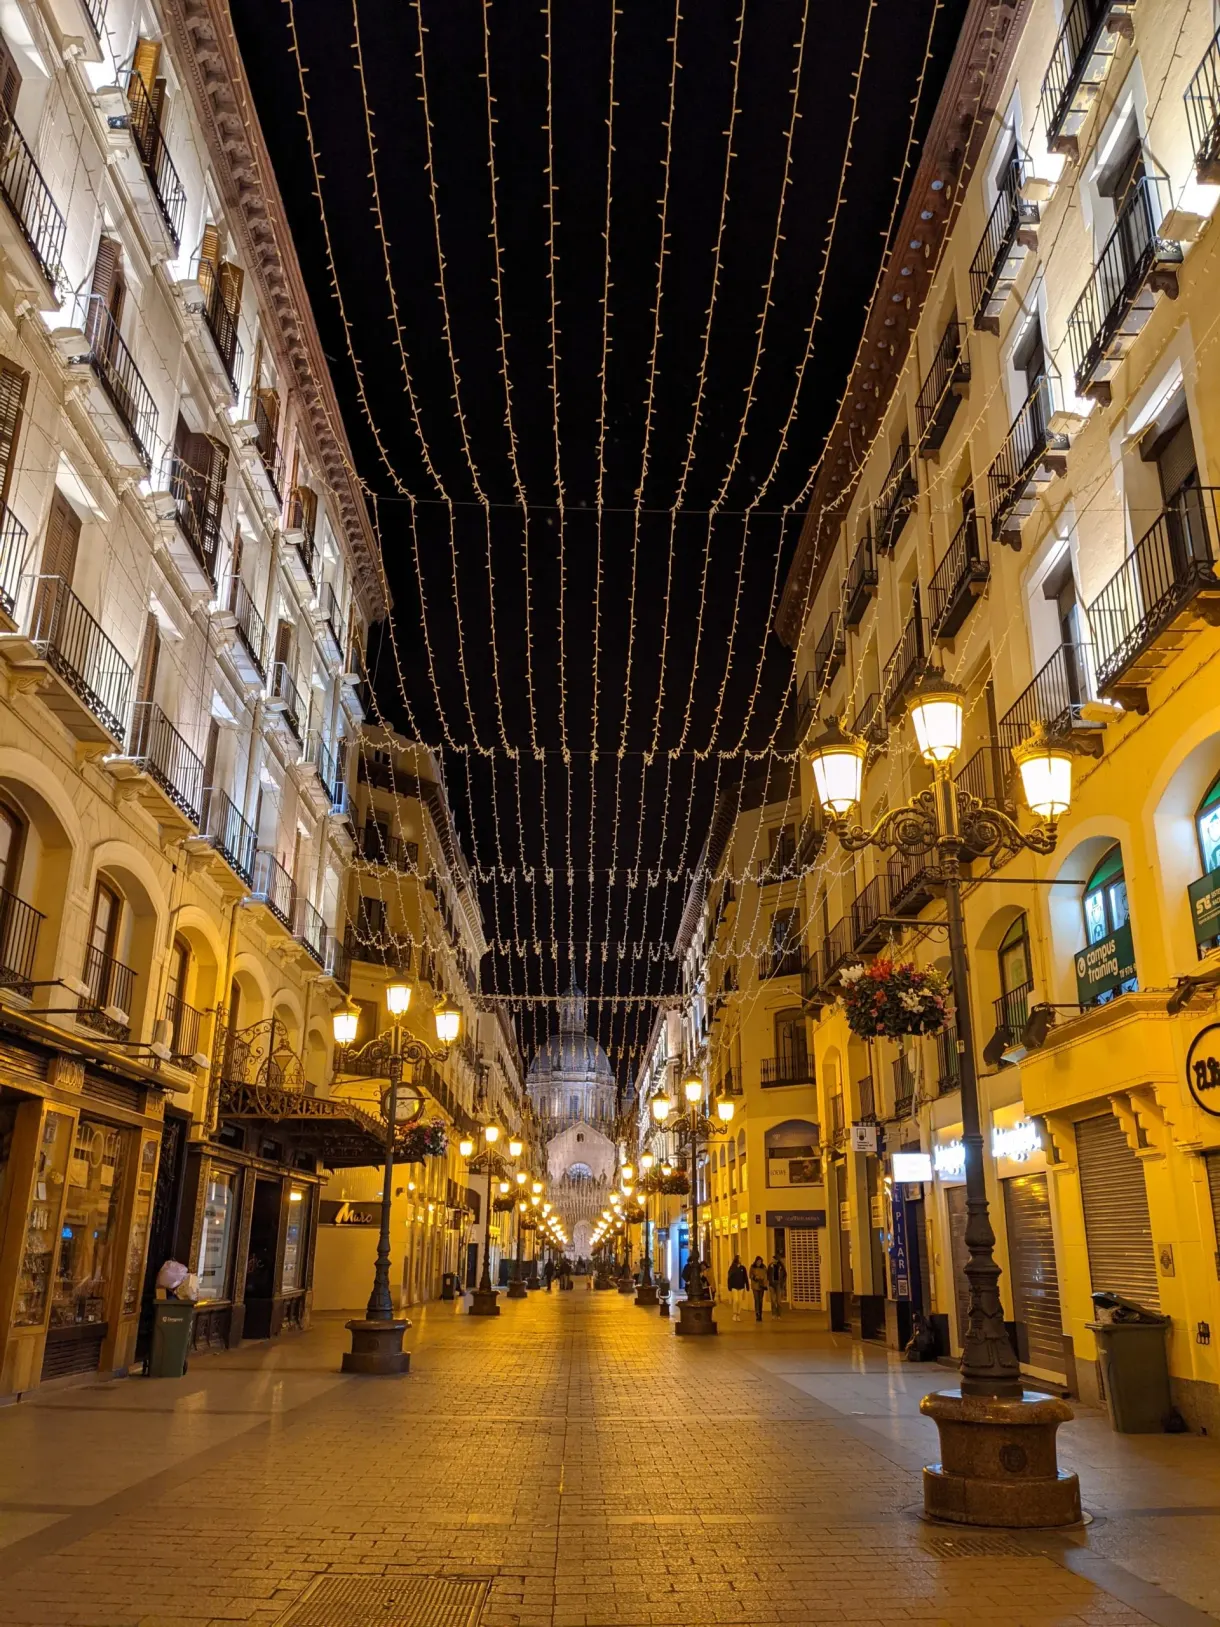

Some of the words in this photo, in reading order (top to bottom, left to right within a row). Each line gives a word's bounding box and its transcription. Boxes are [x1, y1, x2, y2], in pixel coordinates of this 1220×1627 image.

[1086, 939, 1115, 966] campus
[1088, 957, 1118, 983] training
[895, 1211, 904, 1269] PILAR
